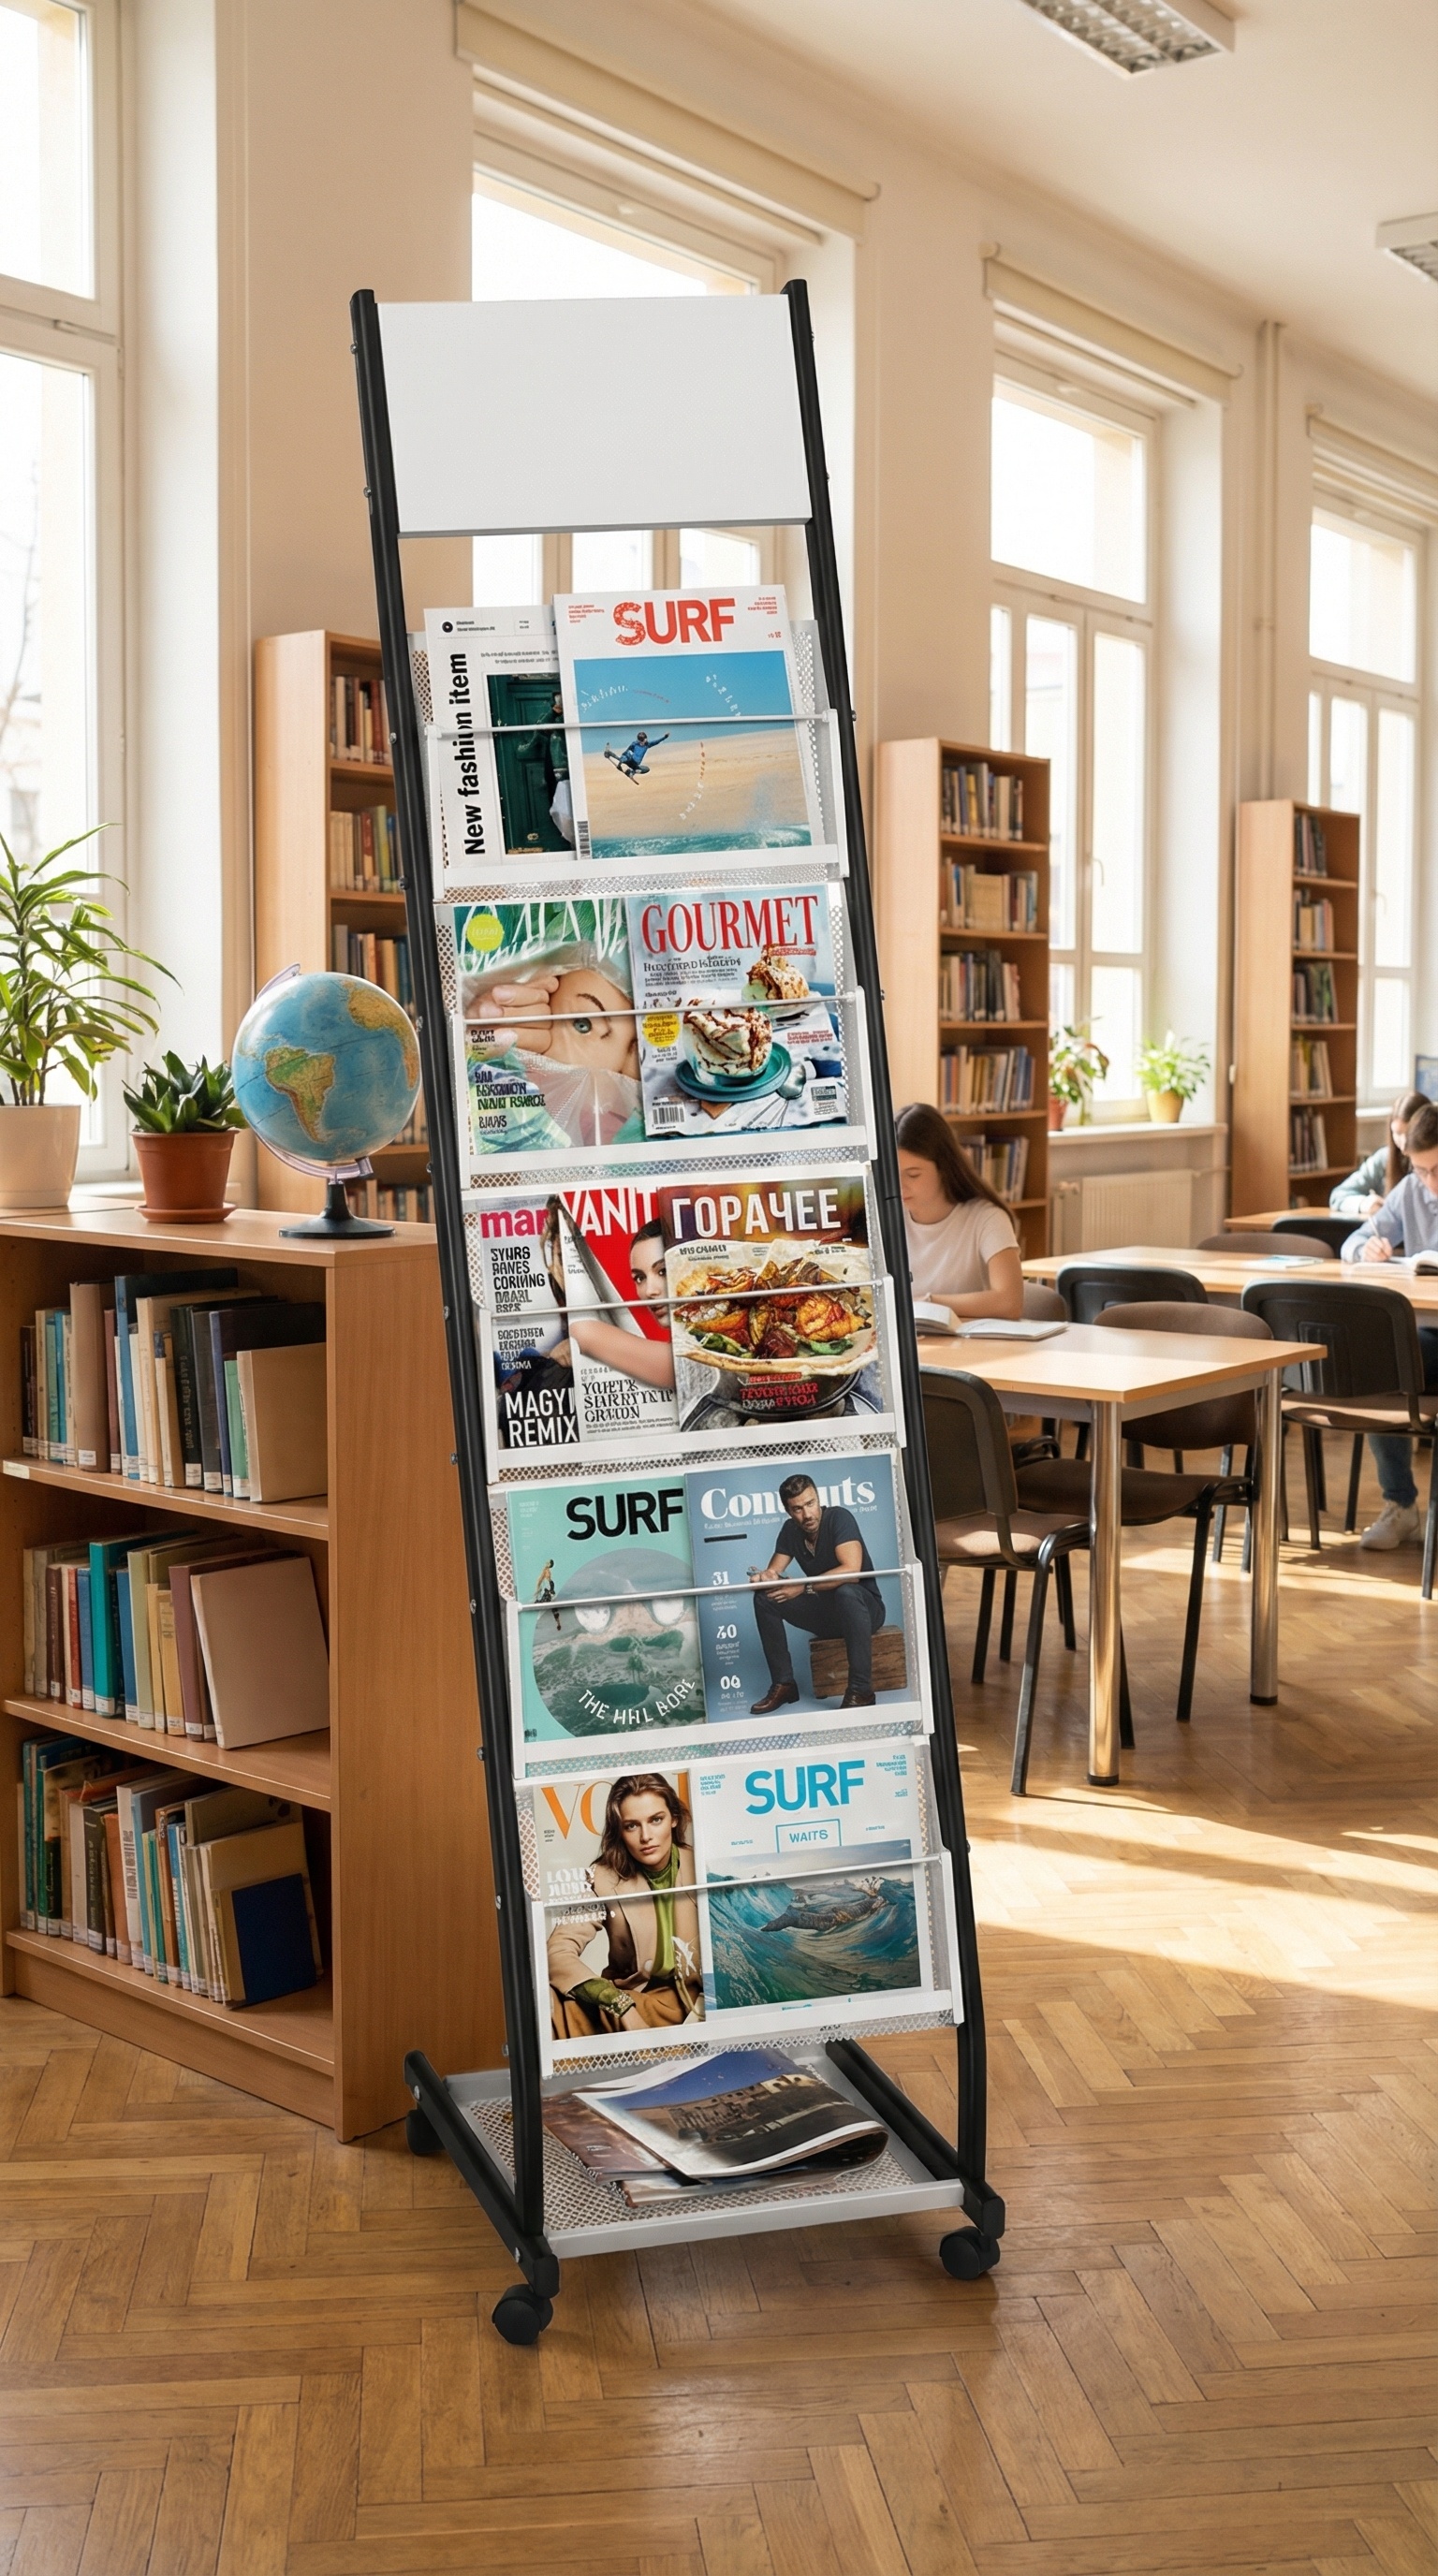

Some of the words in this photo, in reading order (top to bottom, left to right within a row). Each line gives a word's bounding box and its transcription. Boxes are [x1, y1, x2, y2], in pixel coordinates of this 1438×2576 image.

[613, 598, 735, 645] SURF
[449, 653, 471, 705] item
[452, 711, 480, 797] fashion
[463, 804, 486, 856] New
[641, 895, 818, 954] GOURMET
[672, 1188, 842, 1239] ГОРАЧЕЕ
[508, 1415, 579, 1448] REMIX
[566, 1488, 683, 1541] SURF
[578, 1689, 610, 1720] THE
[745, 1760, 864, 1815] SURF
[789, 1829, 829, 1843] WAITS
